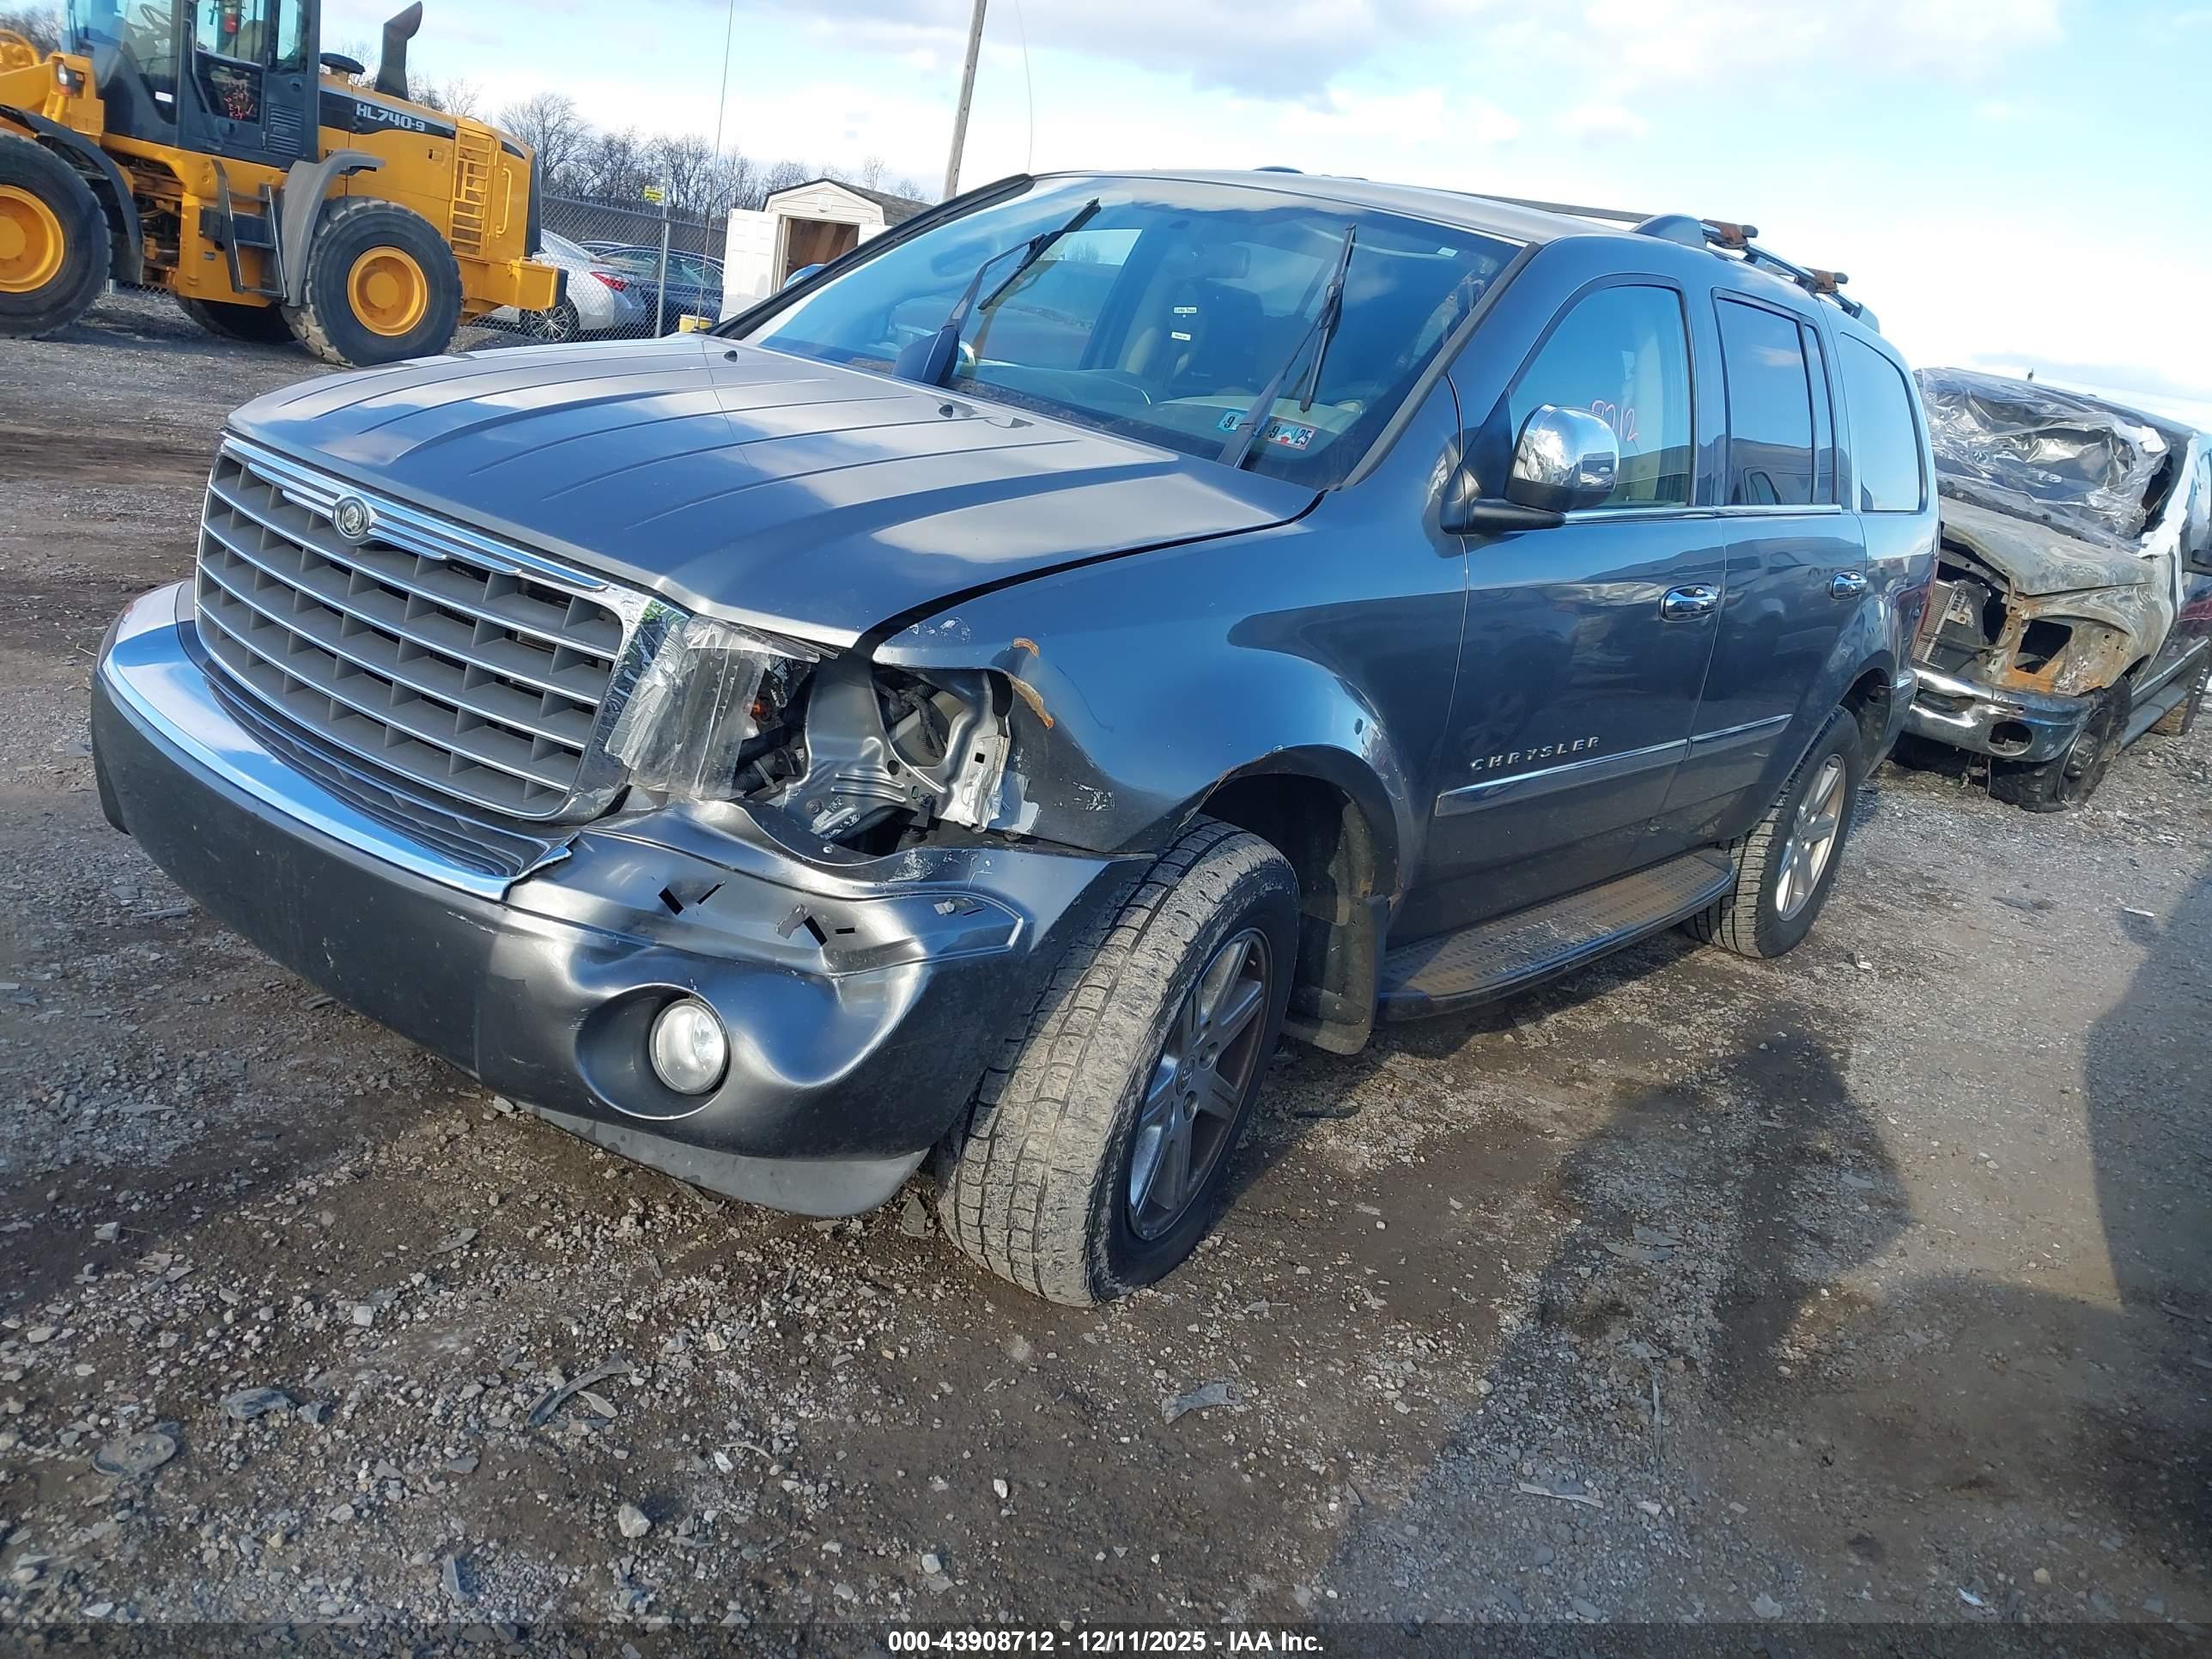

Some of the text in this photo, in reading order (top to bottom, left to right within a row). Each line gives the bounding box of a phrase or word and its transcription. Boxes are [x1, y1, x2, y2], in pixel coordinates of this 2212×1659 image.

[356, 102, 426, 132] HL740-9
[1295, 427, 1313, 446] 25
[1470, 736, 1601, 770] CHRYSLER
